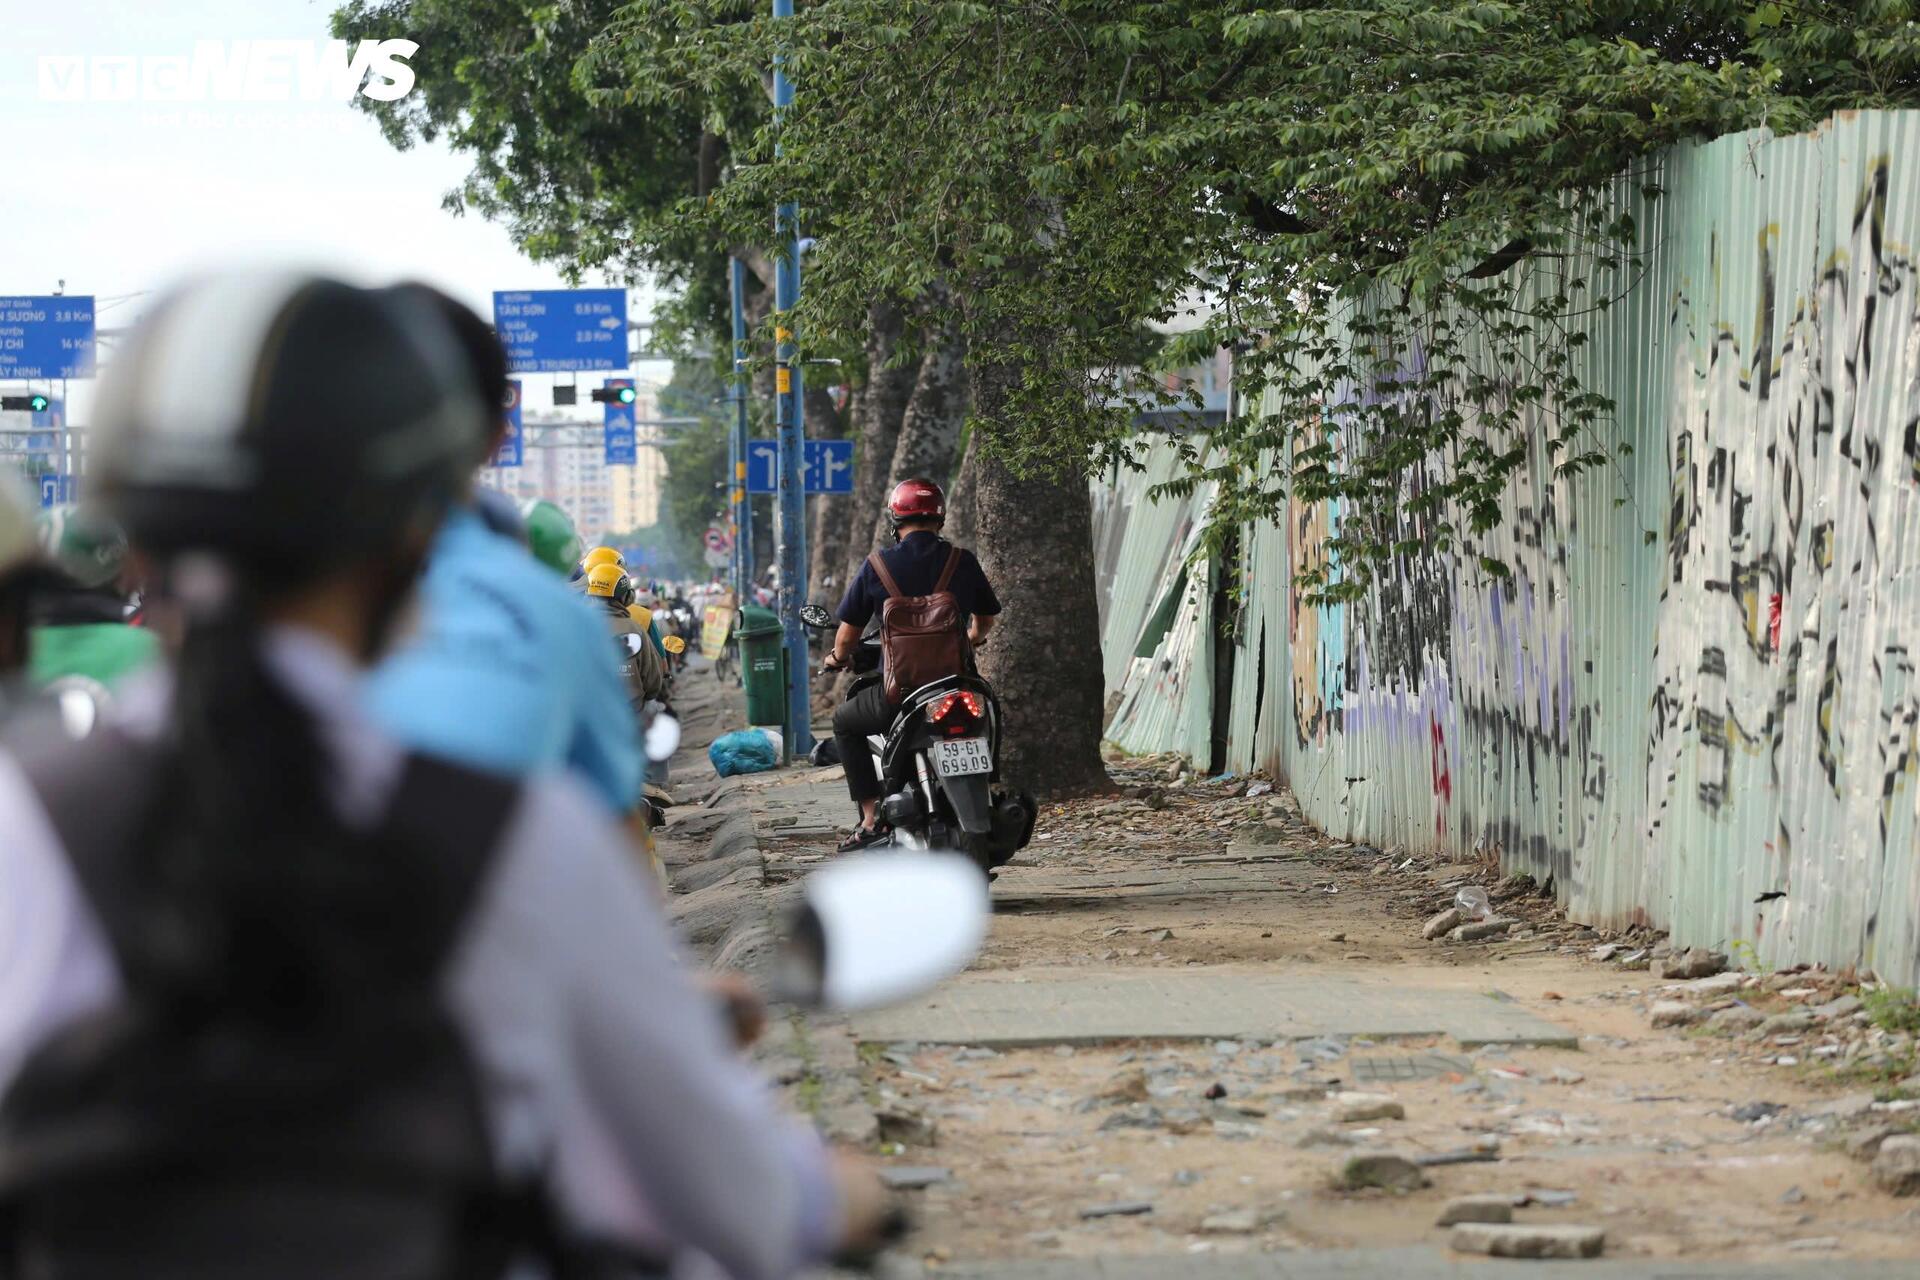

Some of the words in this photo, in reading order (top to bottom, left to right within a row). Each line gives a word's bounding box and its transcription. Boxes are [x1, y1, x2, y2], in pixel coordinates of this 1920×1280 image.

[73, 311, 92, 322] Km
[943, 741, 980, 758] 59-G1
[942, 755, 989, 774] 699.09
